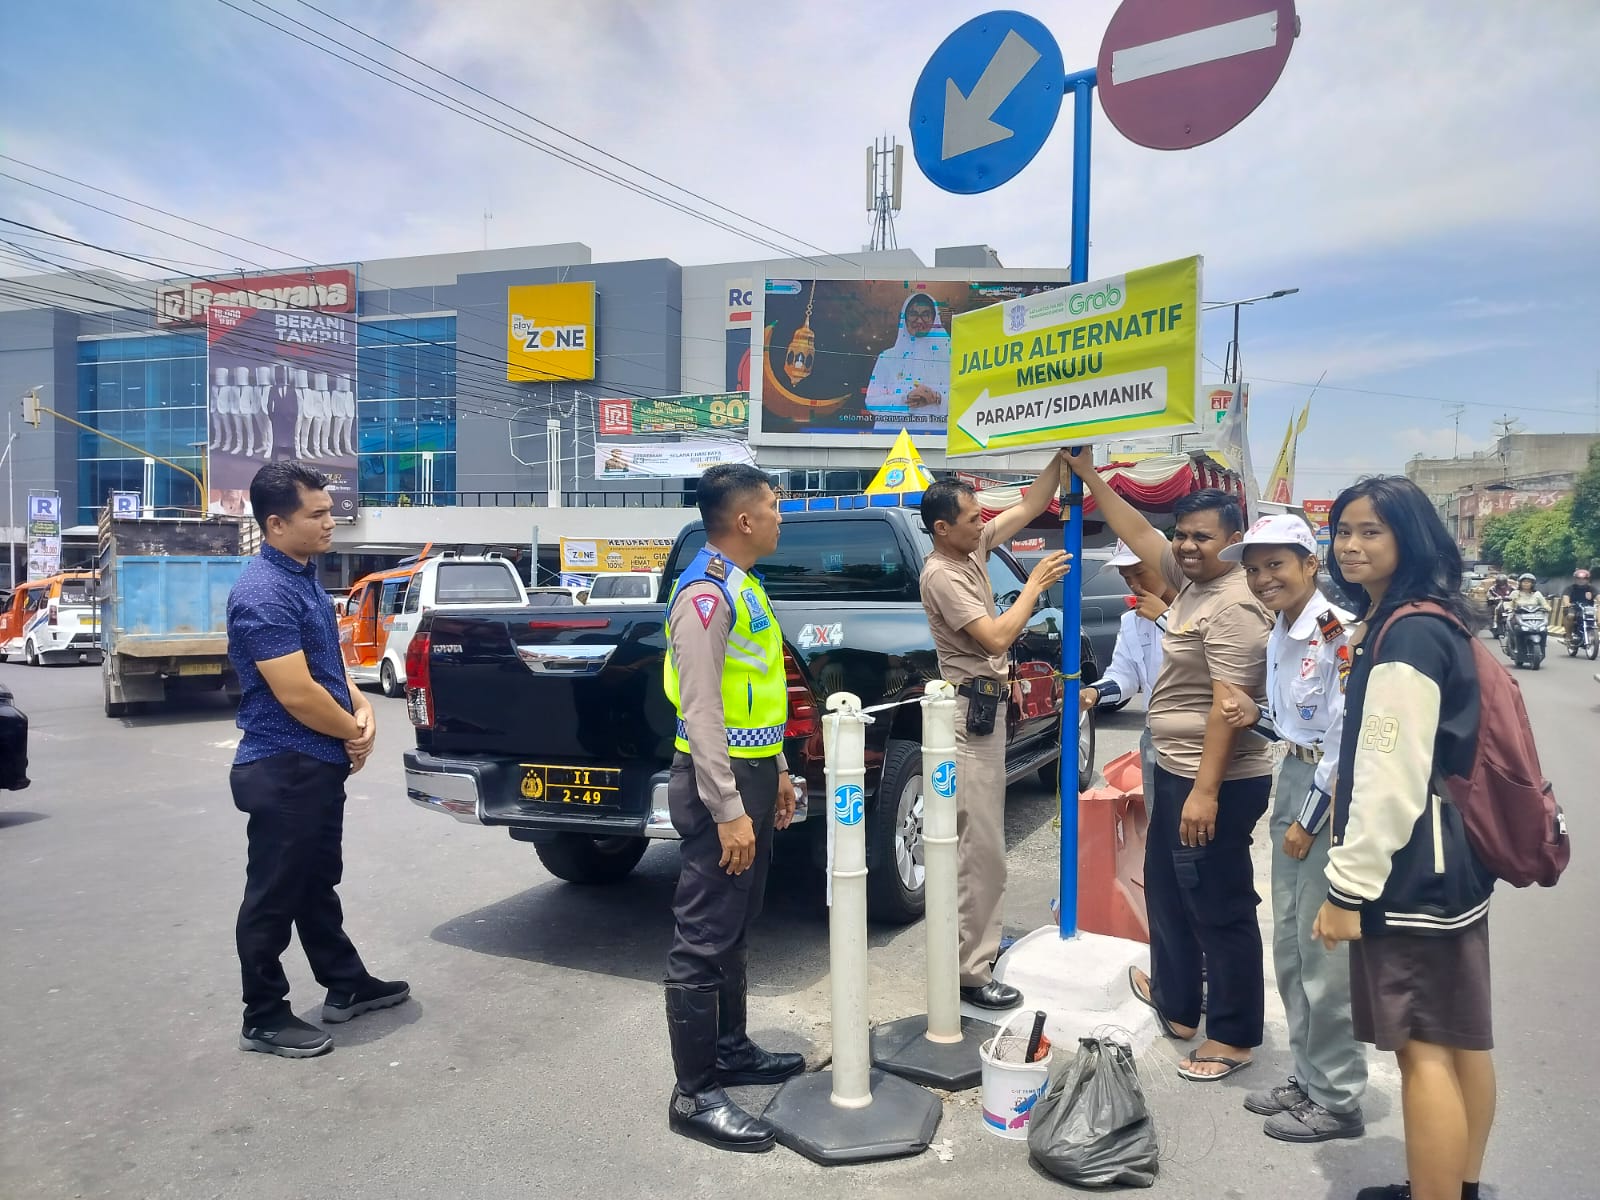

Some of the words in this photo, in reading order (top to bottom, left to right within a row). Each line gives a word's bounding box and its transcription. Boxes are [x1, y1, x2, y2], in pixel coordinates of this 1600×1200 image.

[192, 283, 348, 316] Ramayana
[1069, 284, 1122, 315] Grab
[275, 314, 345, 331] BERANI
[512, 321, 531, 331] play
[275, 328, 349, 345] TAMPIL
[526, 329, 585, 349] ZONE
[959, 341, 1024, 375] JALUR
[1029, 303, 1183, 359] ALTERNATIF
[1017, 351, 1103, 387] MENUJU
[976, 381, 1154, 426] PARAPAT/SIDAMANIK
[839, 413, 873, 423] selamat
[37, 499, 52, 514] R
[118, 498, 132, 511] R
[572, 551, 595, 559] ZONE
[432, 644, 464, 654] TOYOTA
[1361, 714, 1400, 754] 29
[573, 770, 590, 785] II
